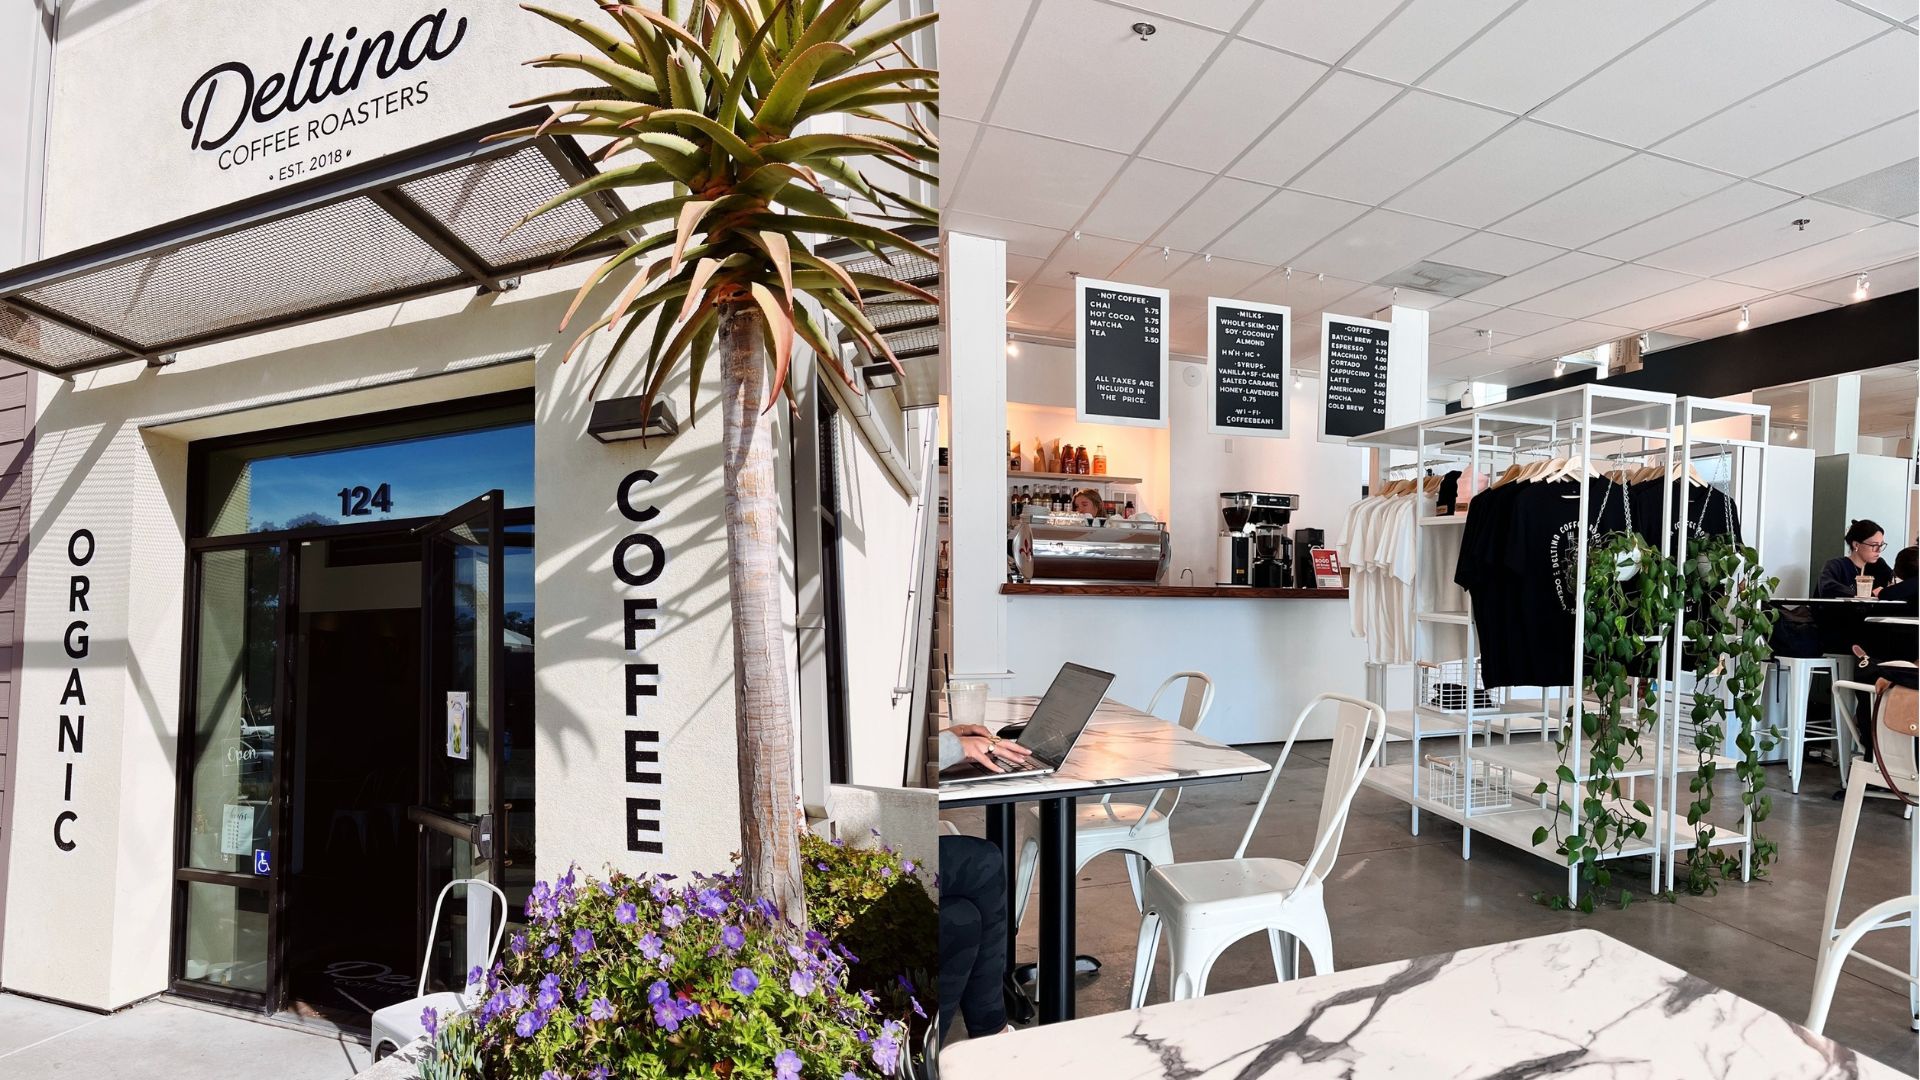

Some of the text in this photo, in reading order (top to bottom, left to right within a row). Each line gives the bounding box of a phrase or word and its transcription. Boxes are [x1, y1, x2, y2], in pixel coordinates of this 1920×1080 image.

[181, 8, 467, 151] Deltina
[218, 81, 429, 170] COFFEE ROASTERS
[279, 149, 342, 181] EST. 2018
[1090, 301, 1110, 309] CHAI
[1108, 313, 1135, 321] COCOA
[1090, 320, 1122, 328] MATCHA
[1236, 338, 1265, 346] ALMOND
[1332, 343, 1363, 351] ESPRESSO
[1331, 351, 1367, 360] MACCHIATO
[1331, 368, 1370, 377] CAPPUCCINO
[1112, 377, 1136, 385] TAXES
[1097, 384, 1134, 393] INCLUDED
[1123, 396, 1146, 404] PRICE.
[338, 483, 393, 516] 124
[612, 469, 665, 854] COFFEE
[53, 528, 95, 852] ORGANIC
[228, 746, 259, 767] Open
